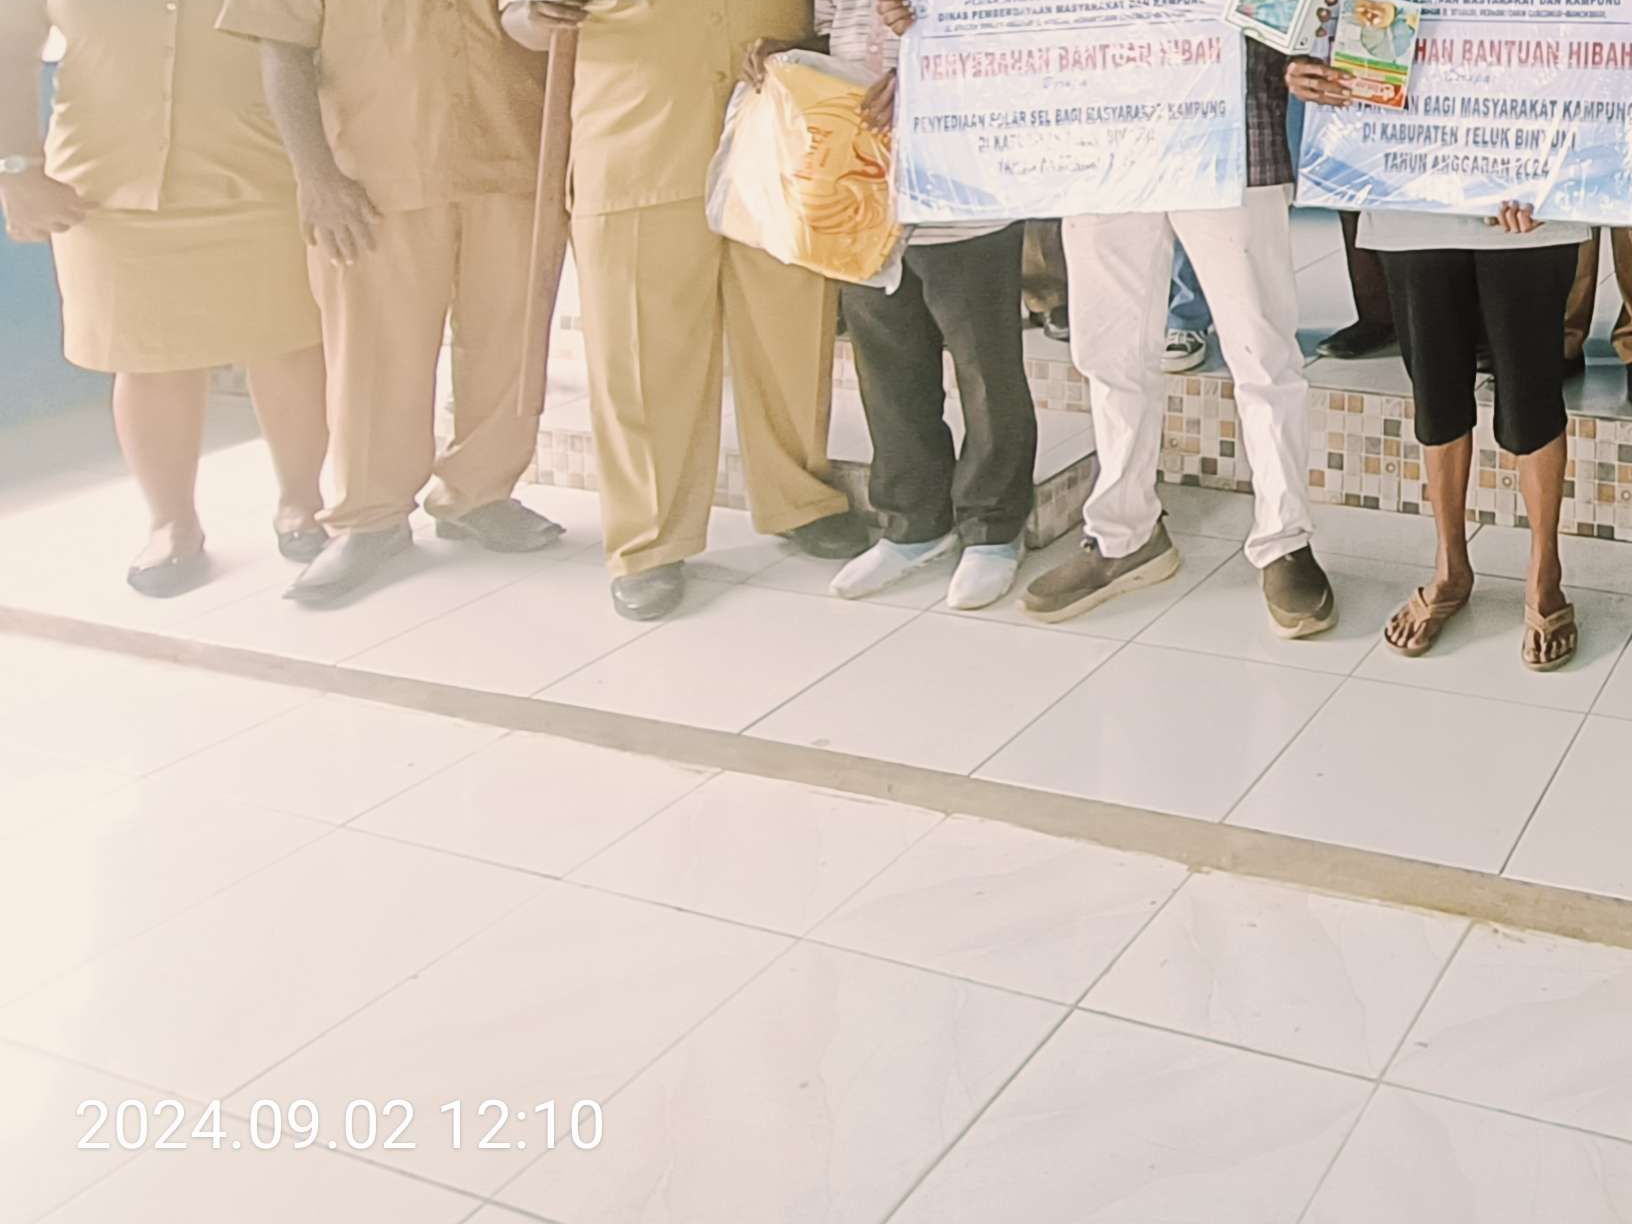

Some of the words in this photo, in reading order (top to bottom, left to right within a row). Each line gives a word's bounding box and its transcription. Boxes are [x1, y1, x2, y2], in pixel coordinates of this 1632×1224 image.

[1462, 38, 1560, 69] BANTUAN
[1030, 109, 1051, 127] SEL
[1055, 107, 1083, 125] BAGI
[1424, 95, 1457, 116] BAGI
[1461, 97, 1557, 120] MASYARAKAT
[1380, 122, 1458, 146] KABUPATEN
[1384, 151, 1428, 174] TAHUN
